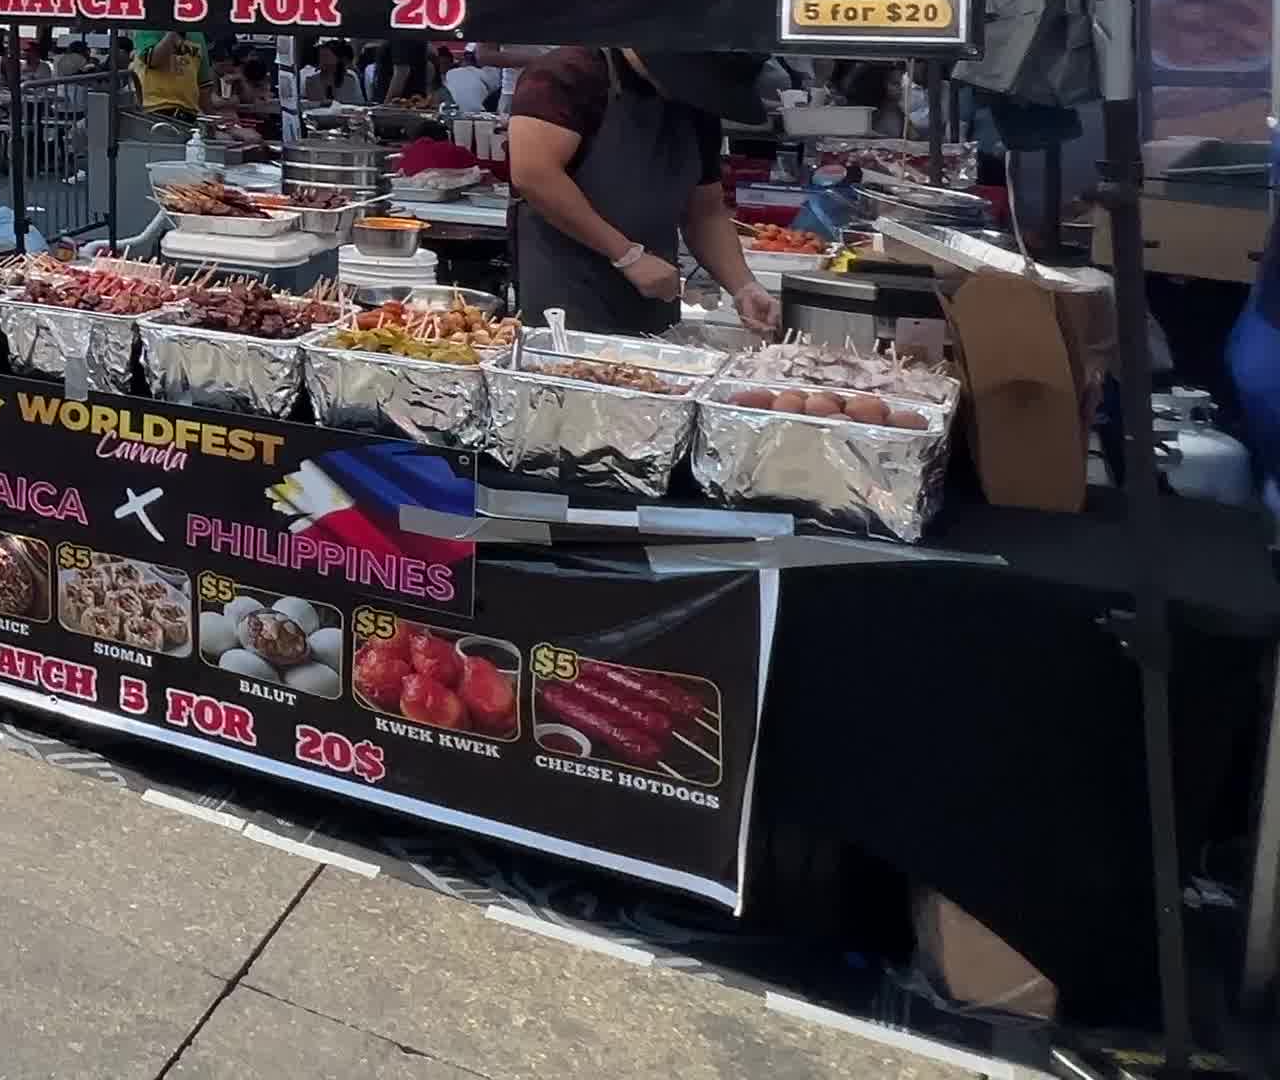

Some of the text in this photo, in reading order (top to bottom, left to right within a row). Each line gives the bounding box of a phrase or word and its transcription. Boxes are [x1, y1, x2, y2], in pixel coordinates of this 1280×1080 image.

[804, 1, 938, 24] 5 for $20
[16, 391, 284, 465] WORLDFEST
[95, 428, 188, 473] Canada
[58, 546, 92, 569] $5
[186, 512, 457, 602] PHILIPPINES
[200, 575, 234, 601] $5
[357, 609, 395, 637] $5
[93, 640, 153, 668] SIOMAI
[534, 647, 577, 680] $5
[239, 679, 297, 707] BALUT
[120, 676, 148, 714] 5
[166, 687, 257, 746] FOR
[295, 723, 386, 784] 20$
[375, 716, 501, 759] KWEK KWEK
[535, 755, 721, 810] CHEESE HOTDOGS
